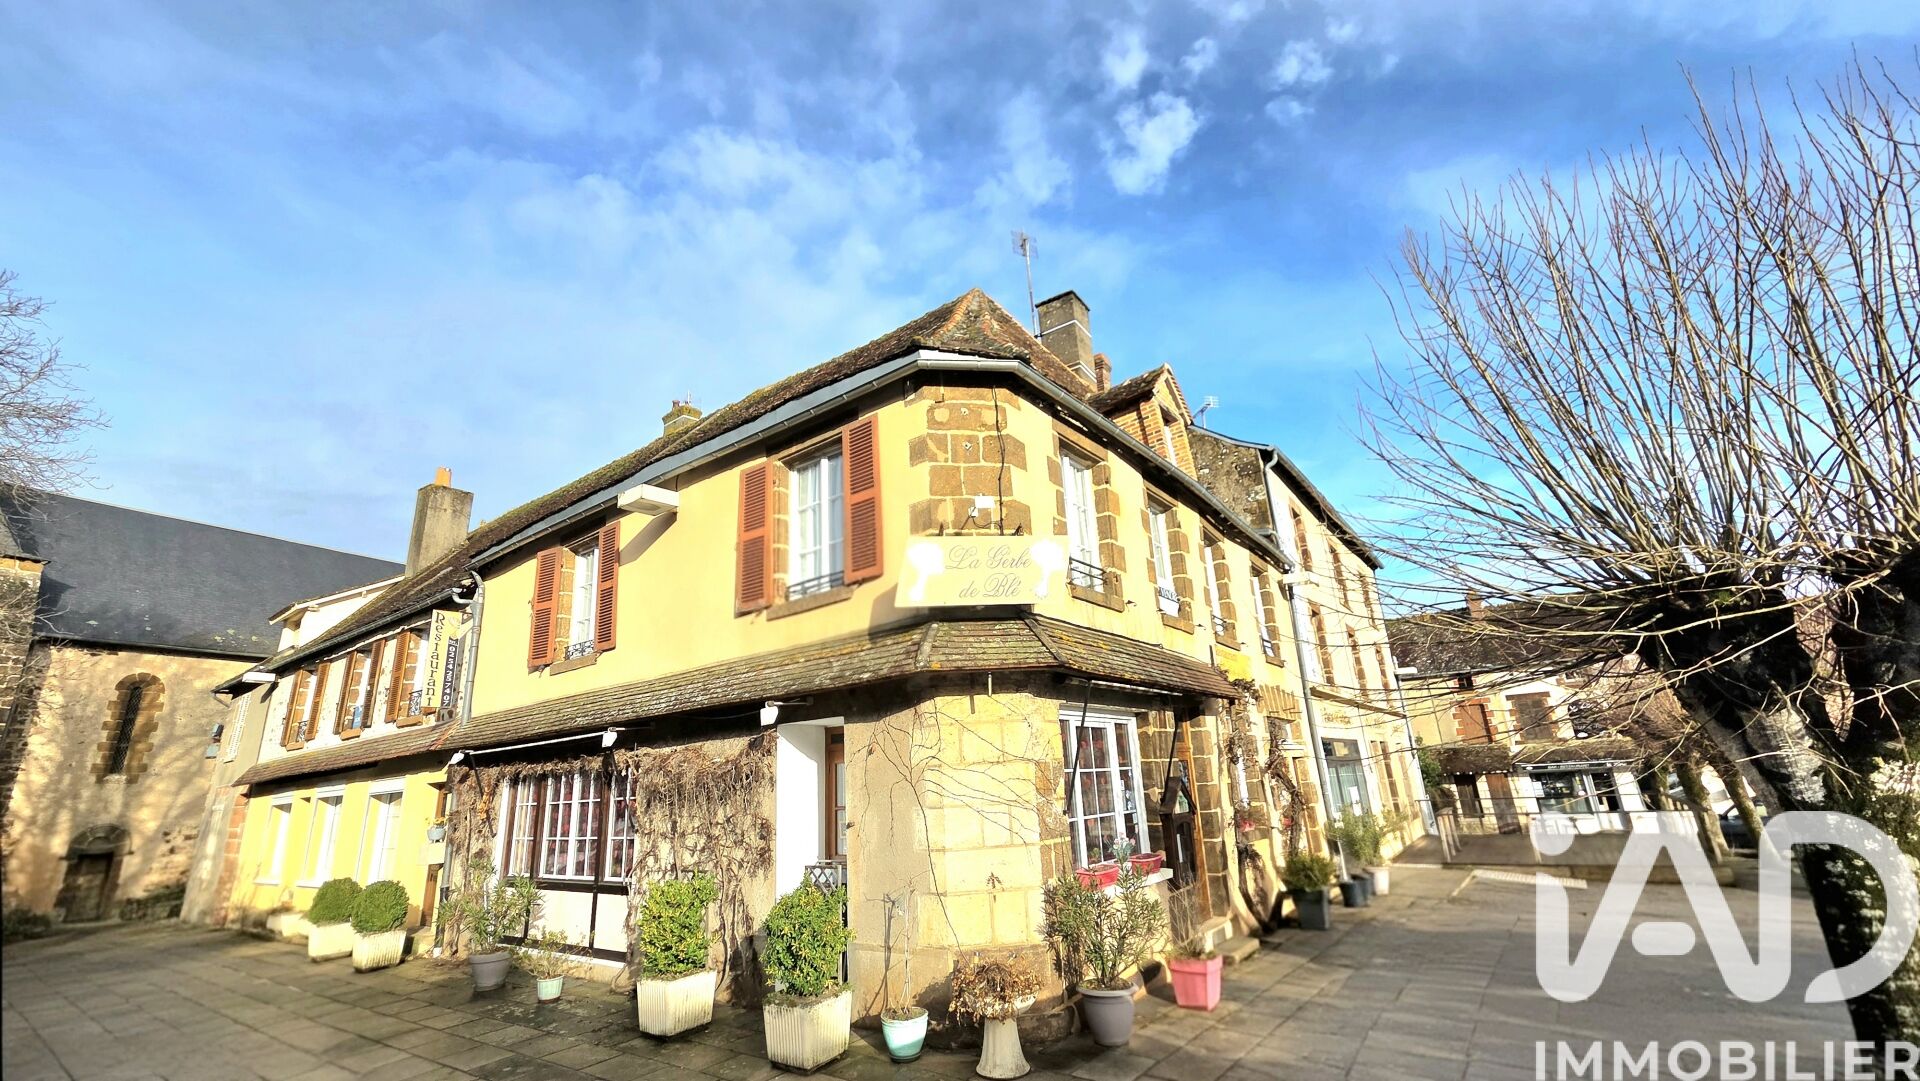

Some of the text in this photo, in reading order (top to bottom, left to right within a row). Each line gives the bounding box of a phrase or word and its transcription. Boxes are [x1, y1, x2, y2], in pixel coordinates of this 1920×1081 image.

[945, 544, 1032, 569] La Gerbe
[958, 572, 1022, 599] de Blé
[426, 611, 446, 706] Restaurant
